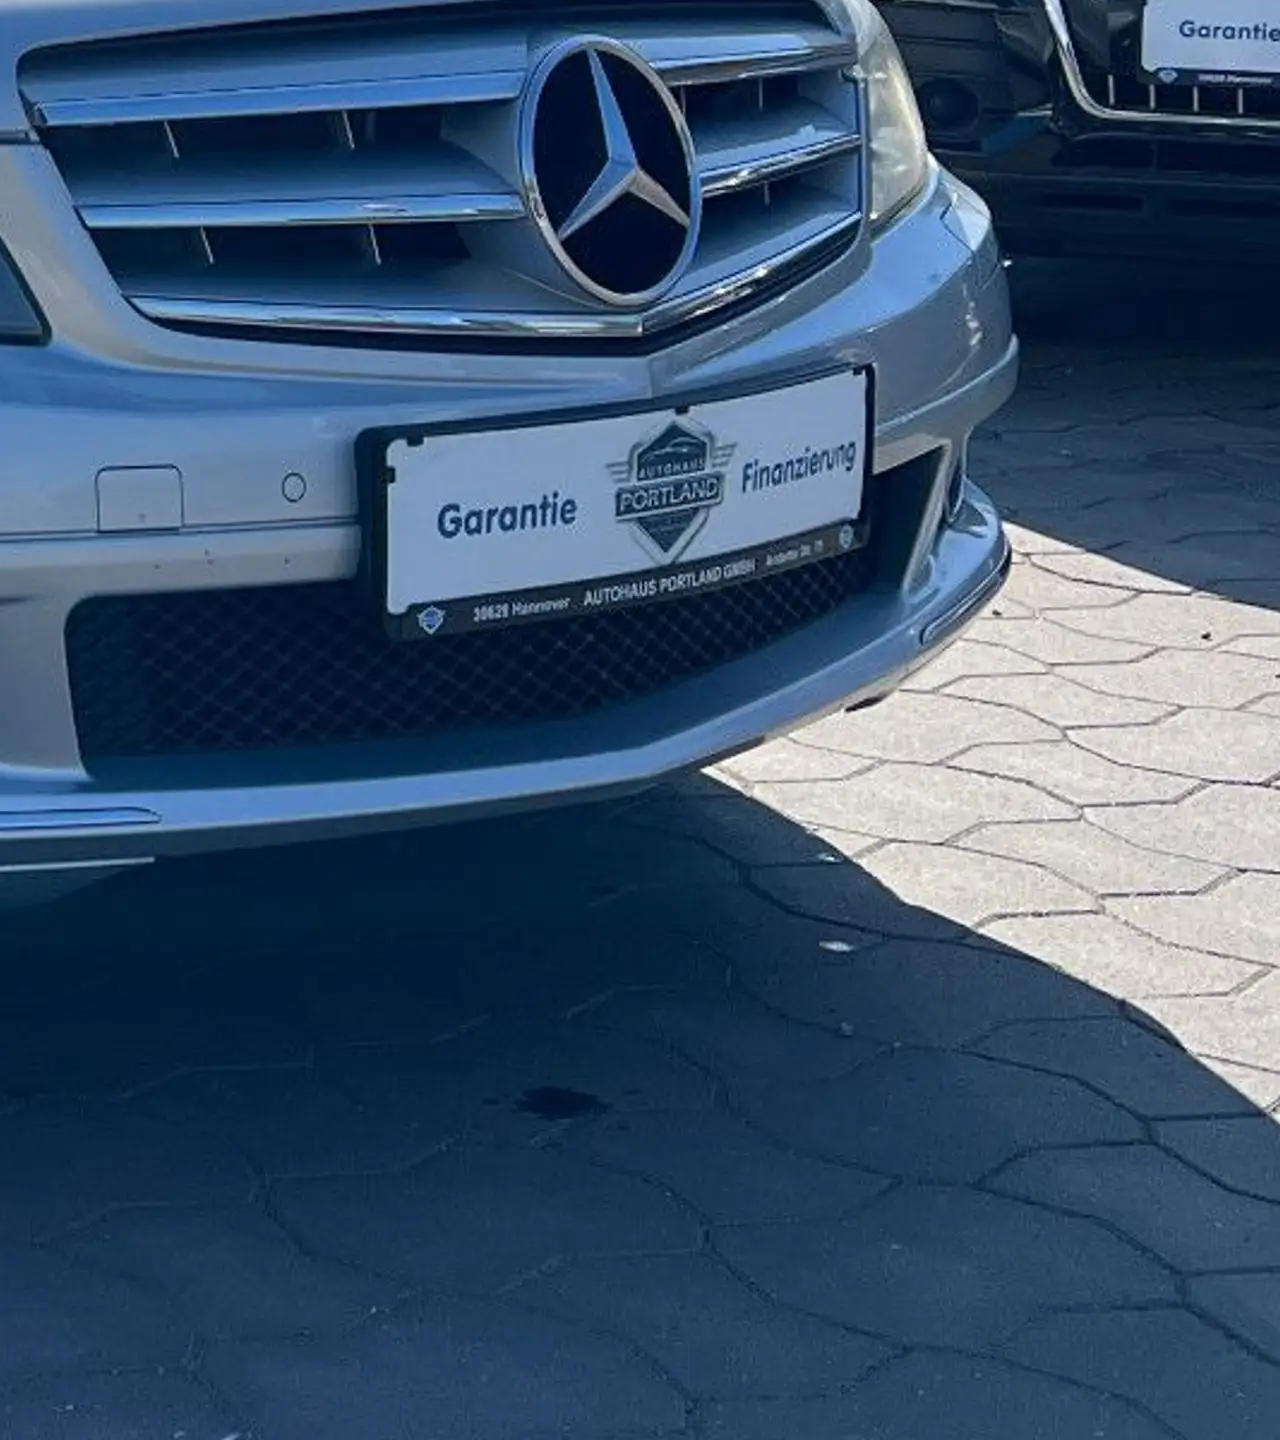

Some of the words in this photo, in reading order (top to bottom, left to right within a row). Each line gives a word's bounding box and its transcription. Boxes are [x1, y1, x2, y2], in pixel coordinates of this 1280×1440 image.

[1178, 19, 1280, 42] Garantie
[742, 441, 857, 494] Finanzierung
[437, 490, 578, 539] Garantie
[620, 477, 718, 512] PORTLAND
[583, 577, 657, 607] AUTOHAUS
[659, 563, 723, 594] PORTLAND
